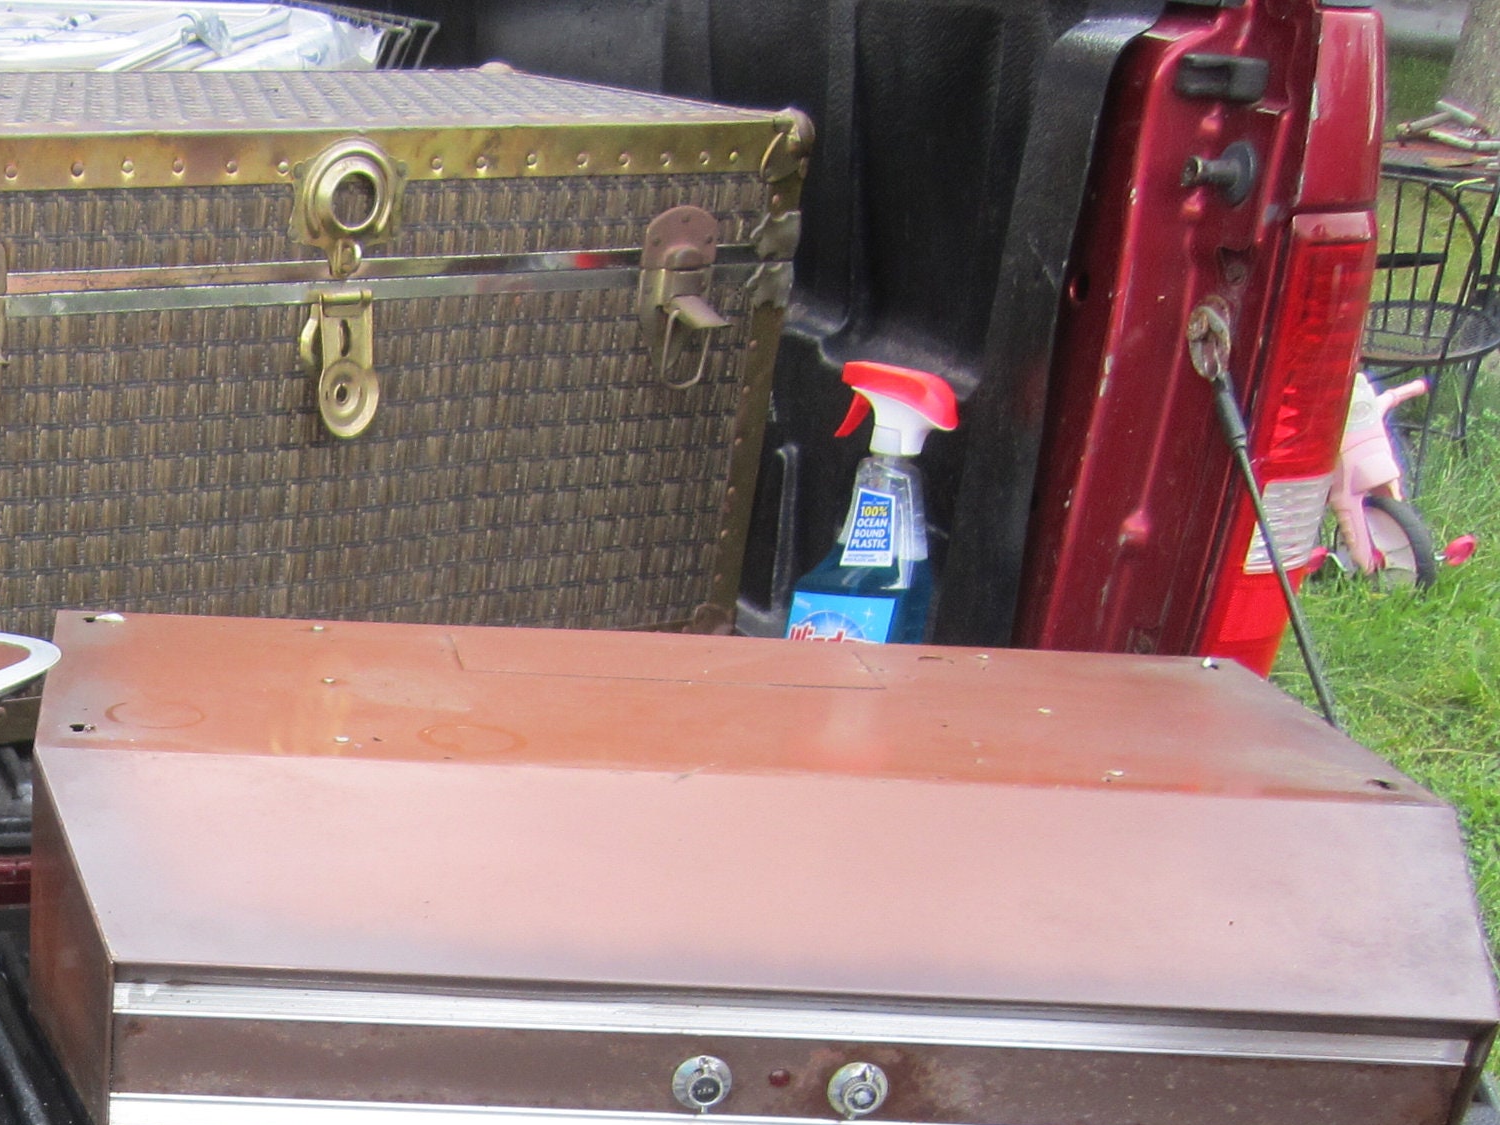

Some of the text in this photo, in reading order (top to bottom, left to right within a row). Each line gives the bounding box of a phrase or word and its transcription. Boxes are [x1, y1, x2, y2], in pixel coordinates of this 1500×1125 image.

[861, 506, 888, 517] 100%
[856, 518, 888, 528] OCEAN
[854, 528, 885, 538] BOUND
[850, 538, 888, 549] PLASTIC
